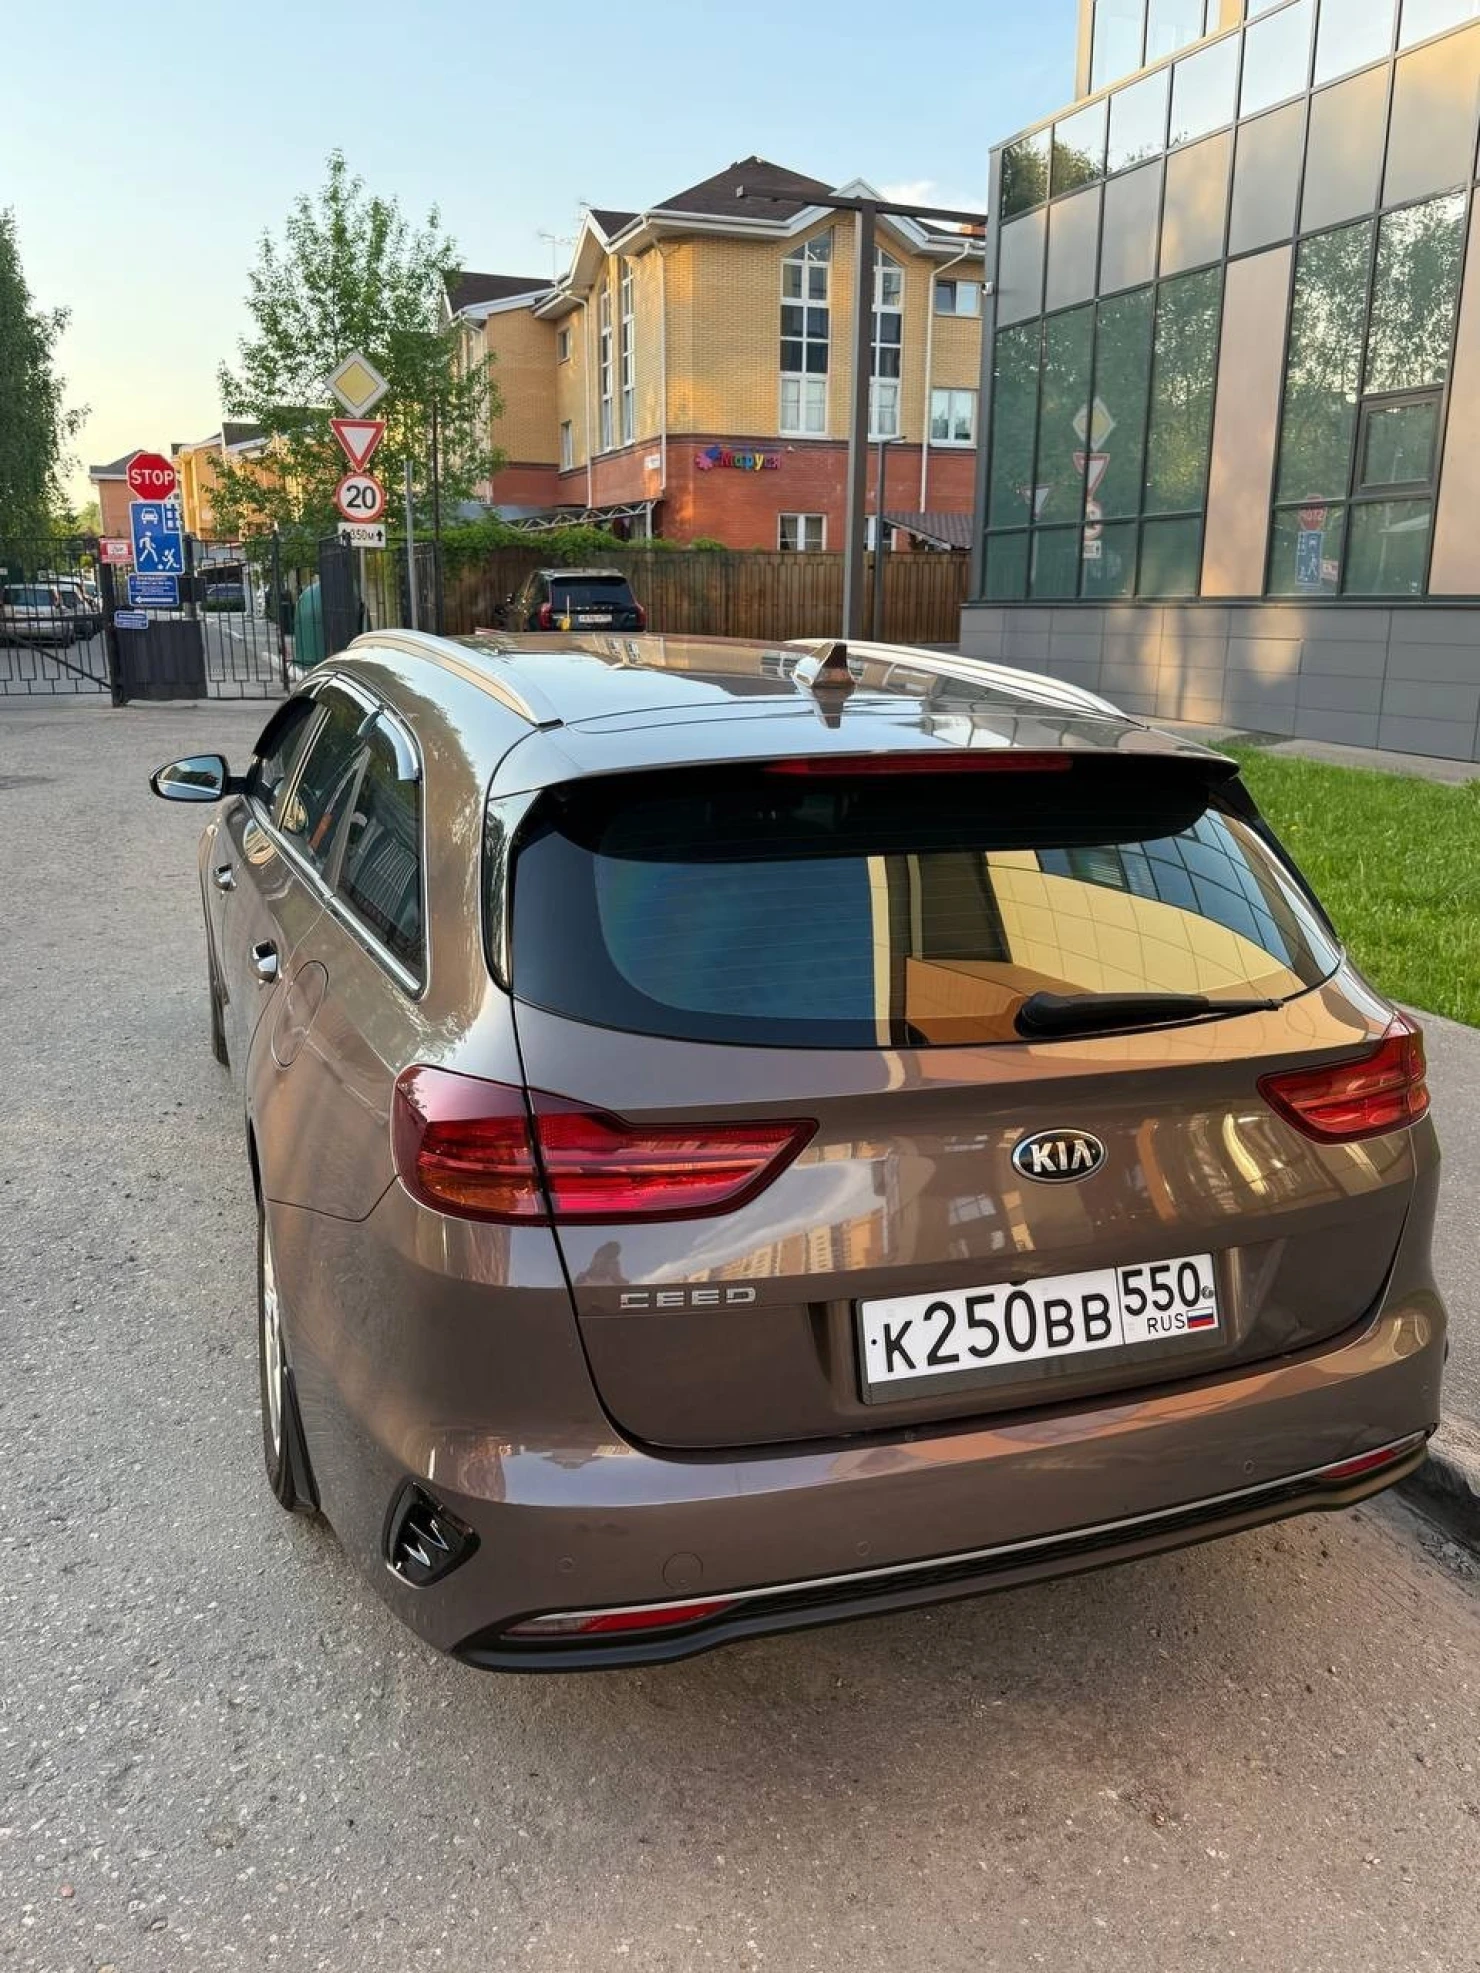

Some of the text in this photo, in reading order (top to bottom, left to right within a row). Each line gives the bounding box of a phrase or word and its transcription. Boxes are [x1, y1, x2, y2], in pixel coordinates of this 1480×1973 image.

[130, 469, 174, 486] STOP
[346, 485, 376, 509] 20
[1030, 1140, 1093, 1172] KIA
[620, 1287, 756, 1308] CEED
[1121, 1261, 1201, 1316] 550
[1147, 1312, 1186, 1335] RUS
